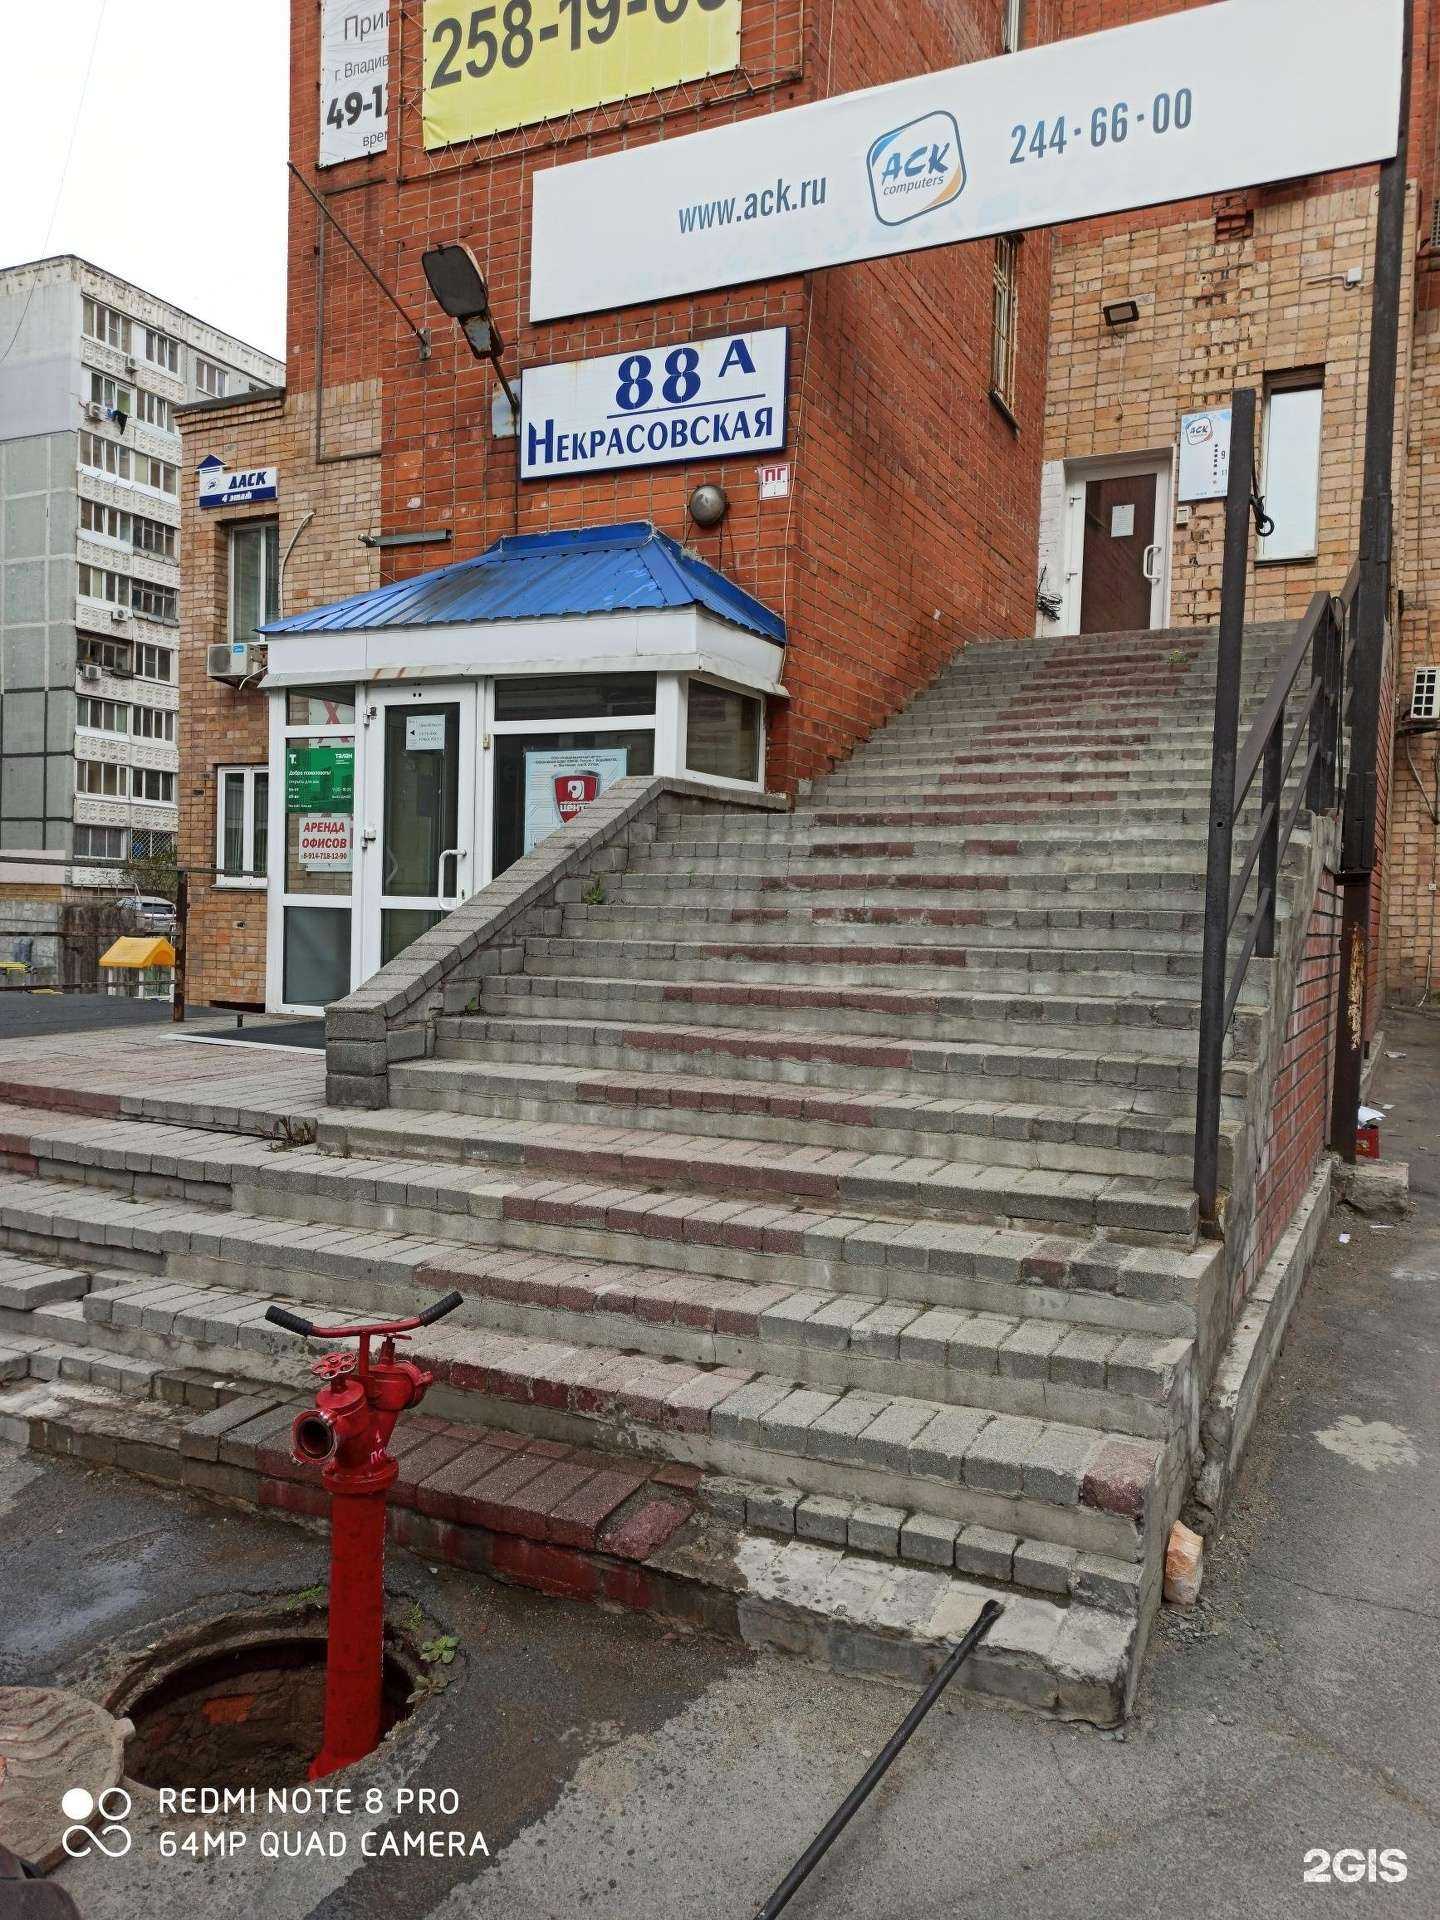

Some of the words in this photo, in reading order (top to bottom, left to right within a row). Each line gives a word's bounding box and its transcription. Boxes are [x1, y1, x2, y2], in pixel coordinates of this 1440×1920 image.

[431, 0, 728, 89] 258-19-
[327, 83, 389, 129] 49-1
[883, 175, 944, 196] computers
[679, 177, 826, 234] www.ack.ru
[615, 347, 701, 410] 88
[765, 467, 787, 481] ПГ
[302, 837, 347, 849] ОФИСОВ
[303, 821, 345, 834] АРЕНДА
